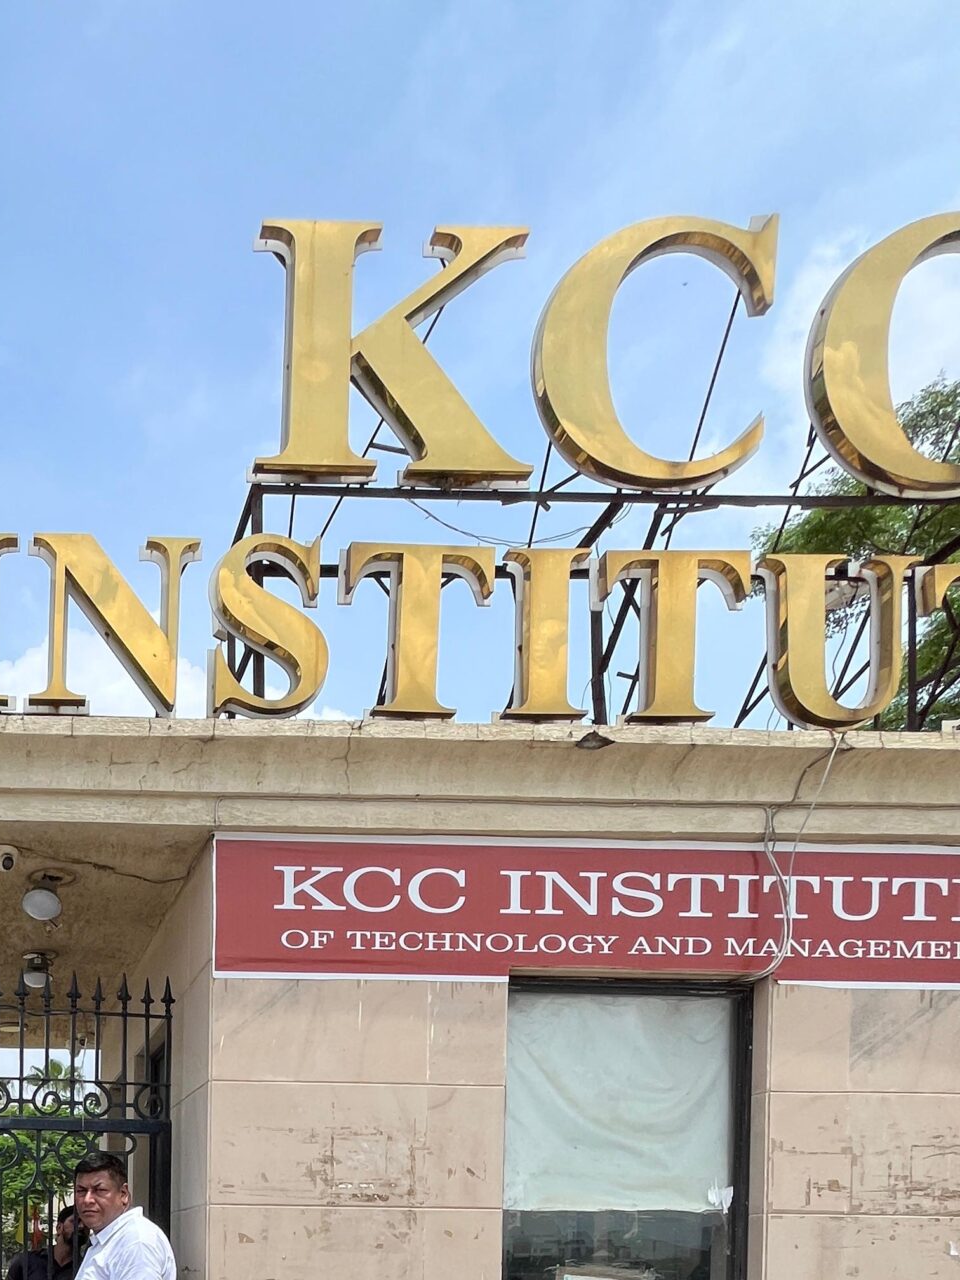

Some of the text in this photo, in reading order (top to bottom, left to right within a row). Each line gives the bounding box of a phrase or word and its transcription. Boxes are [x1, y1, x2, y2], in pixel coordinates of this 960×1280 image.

[249, 213, 960, 498] KCC
[273, 865, 960, 922] KCC INSTITUT
[280, 929, 960, 960] OF TECHNOLOGY AND MANAGEME
